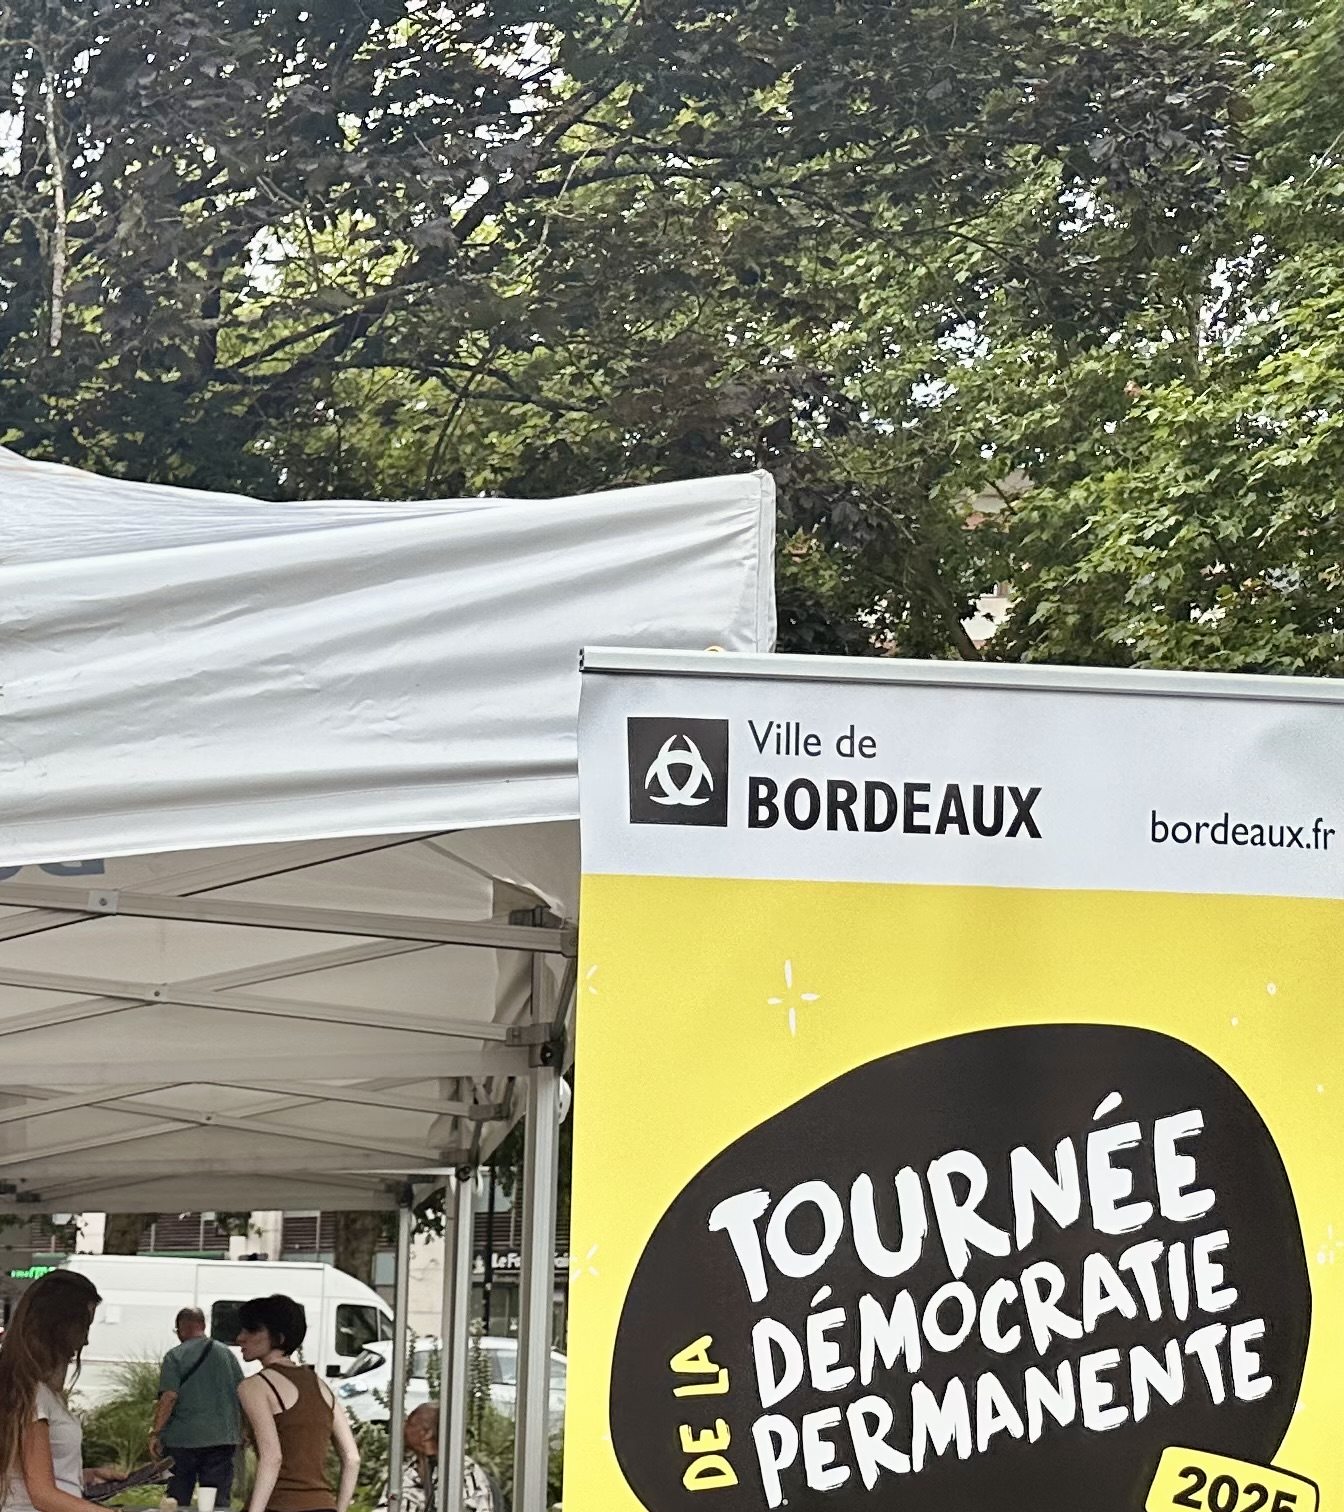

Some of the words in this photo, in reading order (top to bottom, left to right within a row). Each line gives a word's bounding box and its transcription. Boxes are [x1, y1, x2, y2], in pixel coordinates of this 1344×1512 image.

[748, 720, 822, 757] Ville
[837, 725, 877, 759] de
[748, 777, 1043, 839] BORDEAUX
[1151, 811, 1335, 850] bordeaux.fr
[708, 1091, 1215, 1303] TOURNÉE
[751, 1229, 1238, 1408] DÉMOCRATIE
[670, 1334, 728, 1397] LA
[751, 1318, 1273, 1509] PERMANENTE
[682, 1417, 738, 1491] DE
